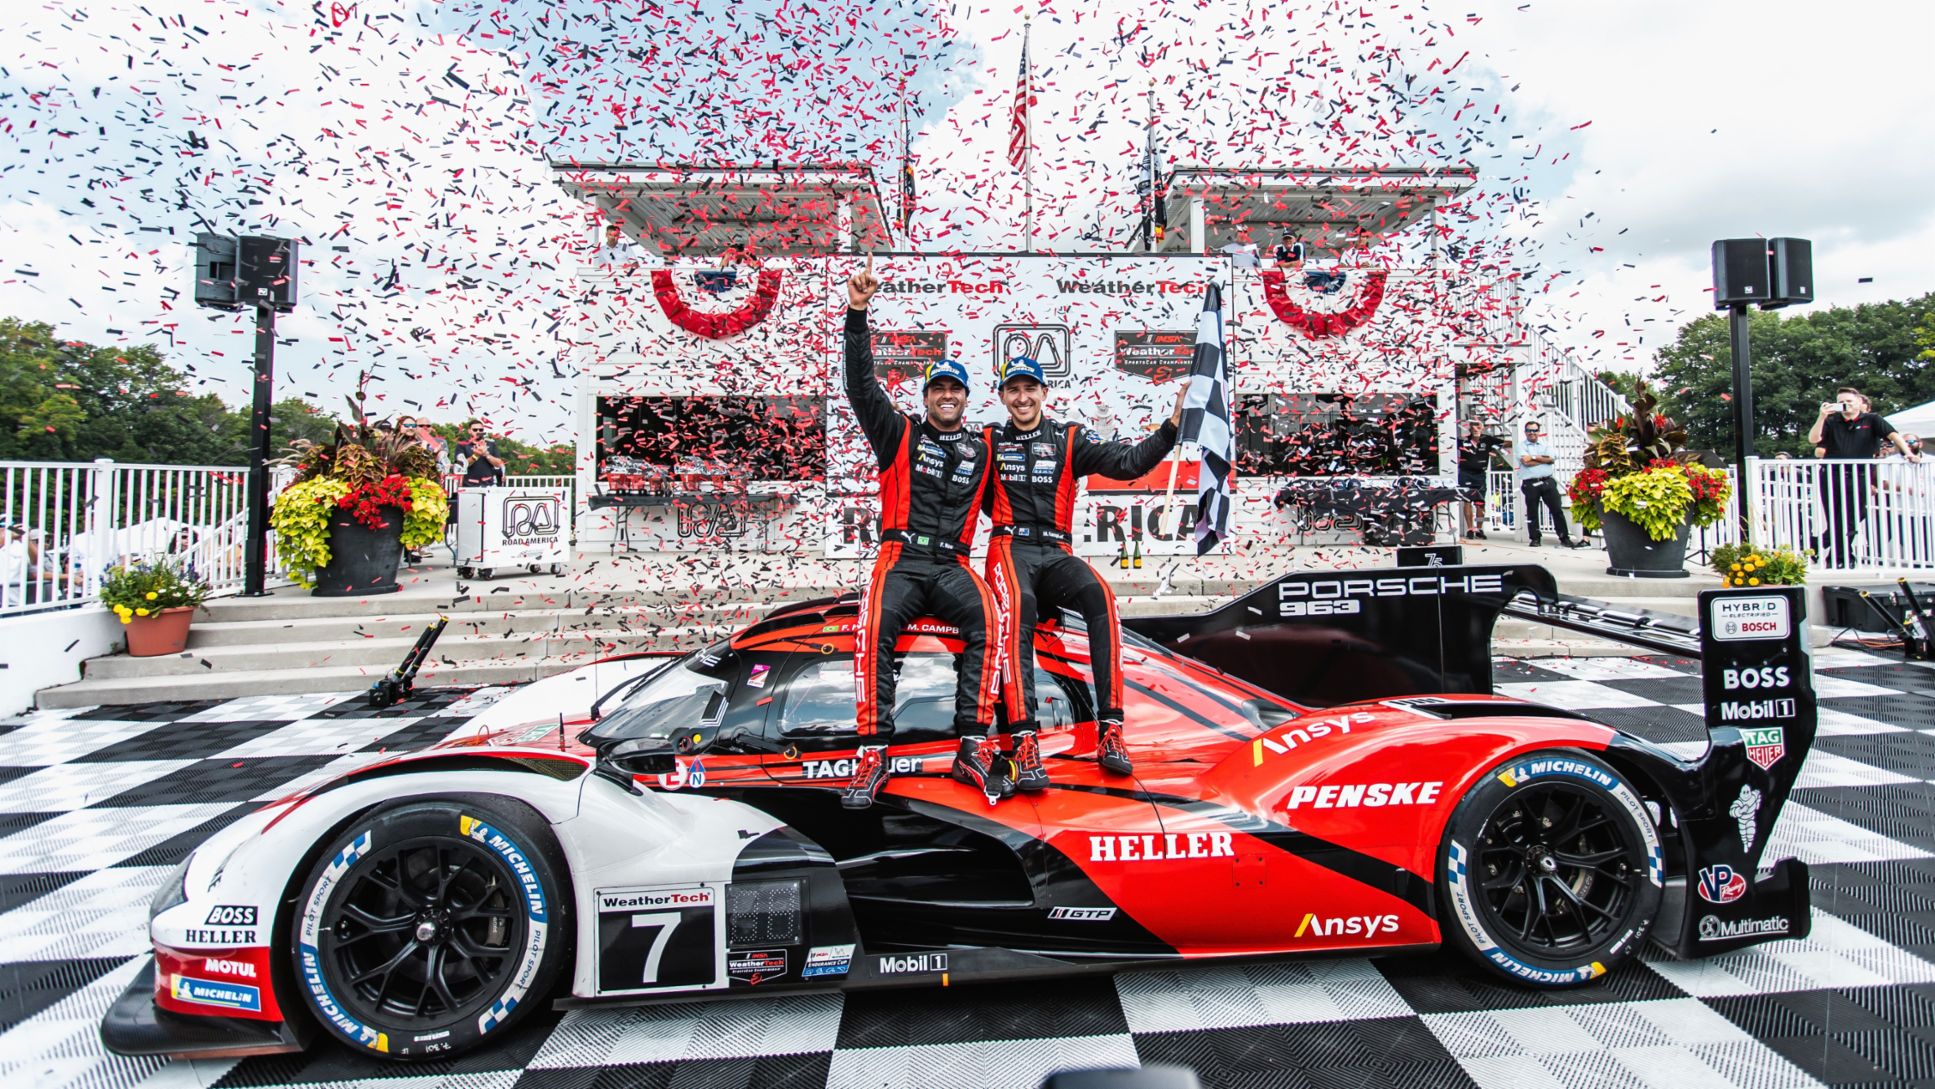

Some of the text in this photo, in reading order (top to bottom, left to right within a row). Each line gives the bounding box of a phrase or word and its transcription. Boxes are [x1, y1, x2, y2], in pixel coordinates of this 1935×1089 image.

[876, 280, 1003, 294] atherTech
[1000, 462, 1026, 473] Ansys
[952, 474, 970, 485] BOSS
[1032, 475, 1053, 484] BOSS
[1083, 504, 1199, 542] RICA
[502, 538, 524, 546] ROAD
[1279, 574, 1502, 600] PORSCHE
[1280, 599, 1360, 617] 963
[1722, 602, 1776, 612] HYBRID
[921, 624, 960, 634] CAMPB
[1742, 622, 1777, 632] BOSCH
[1723, 666, 1790, 690] BOSS
[1721, 700, 1774, 721] Mobil
[1253, 711, 1376, 767] Ansys
[1745, 730, 1780, 745] TAG
[1749, 748, 1781, 770] HEUER
[692, 774, 702, 787] N
[1531, 760, 1612, 786] MICHELIN
[1287, 782, 1443, 809] PENSKE
[1620, 791, 1653, 838] PILOT SPORT
[1089, 832, 1234, 861] HELLER
[488, 835, 543, 915] MICHELIN
[306, 876, 332, 937] PILOT SPORT
[604, 892, 708, 907] WeatherTech
[208, 907, 254, 924] BOSS
[1070, 910, 1111, 918] GTP
[1456, 892, 1486, 944] PILOT SPORT
[186, 929, 256, 943] HELLER
[1294, 913, 1399, 938] Ansys
[1721, 915, 1789, 936] Multimatic
[632, 912, 681, 983] 7
[205, 958, 256, 978] MOTUL
[518, 930, 541, 989] PILOT SPORT
[880, 955, 928, 973] Mobil
[1491, 952, 1575, 983] MICHELIN
[193, 987, 252, 1002] MICHELIN
[303, 952, 360, 1034] MICHELIN
